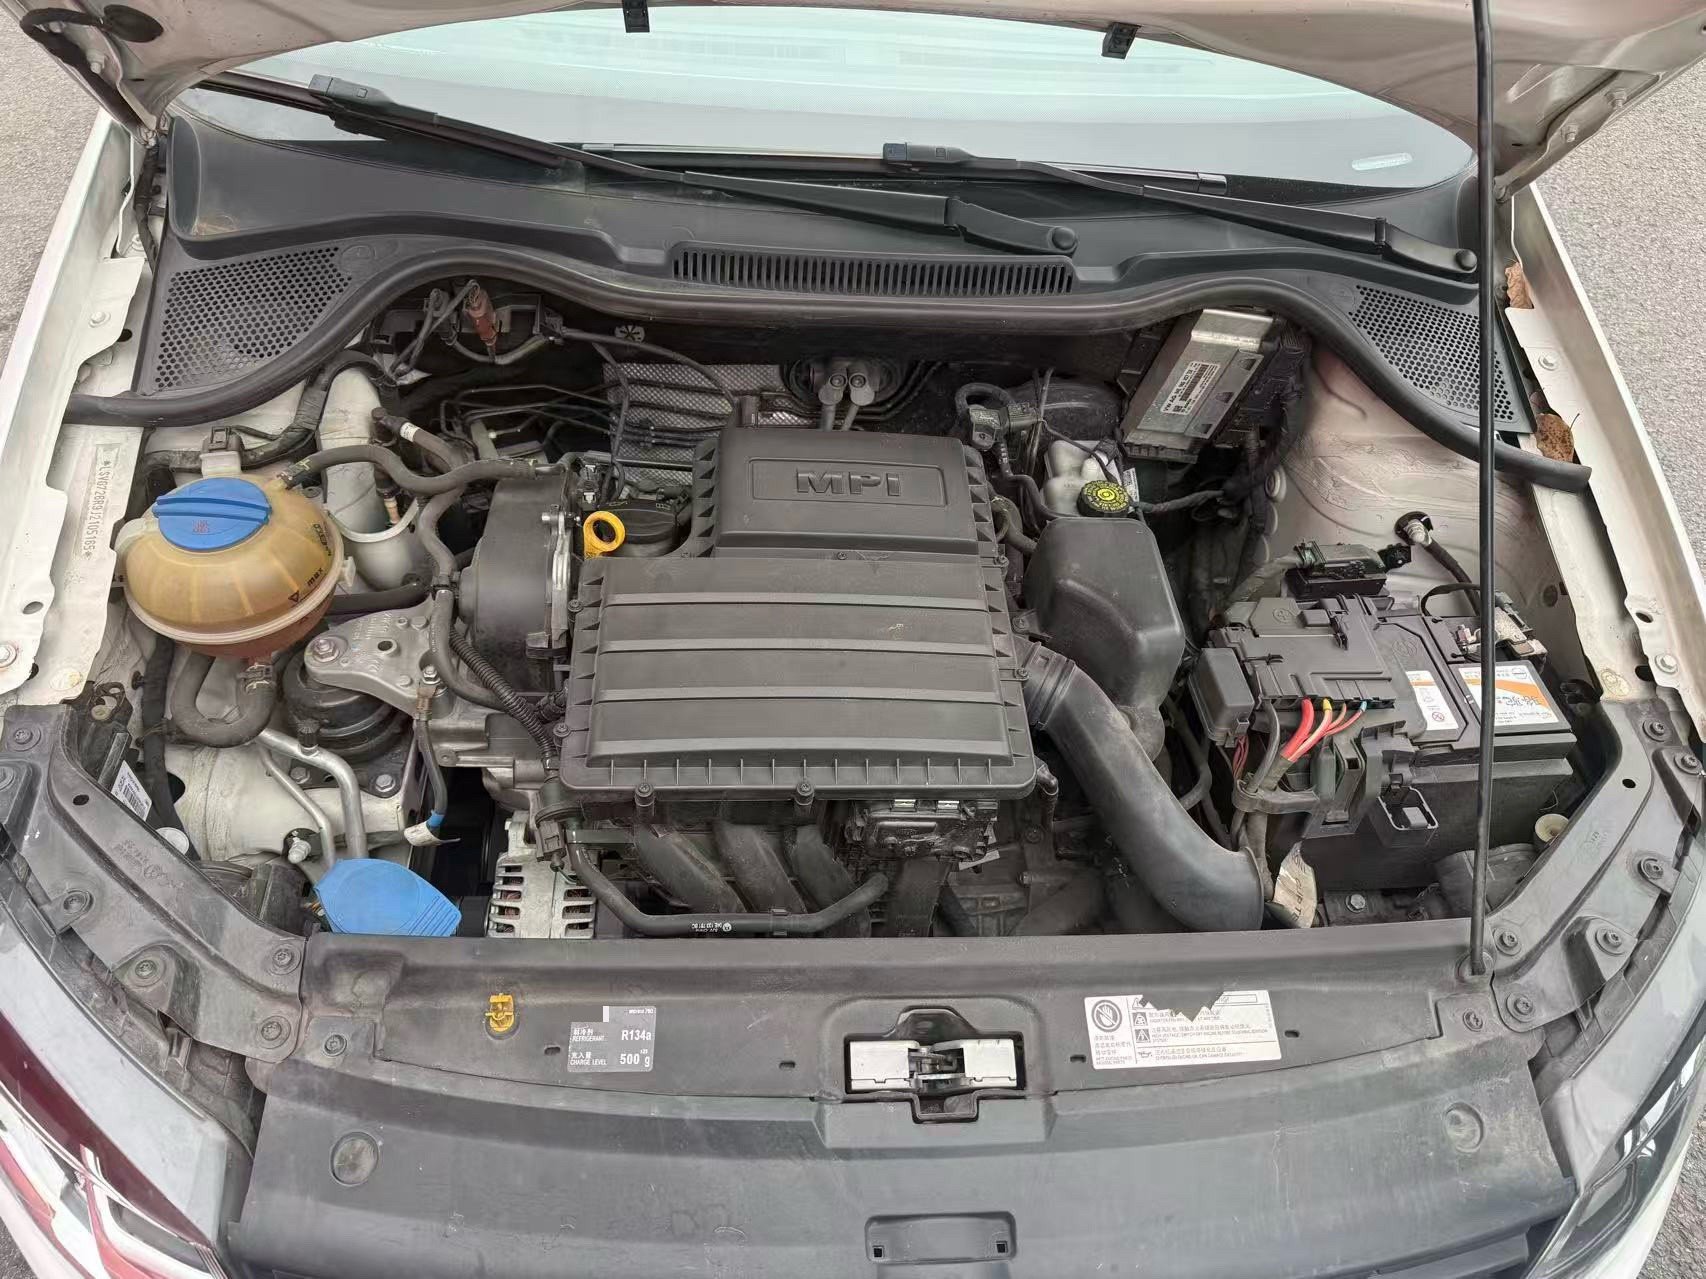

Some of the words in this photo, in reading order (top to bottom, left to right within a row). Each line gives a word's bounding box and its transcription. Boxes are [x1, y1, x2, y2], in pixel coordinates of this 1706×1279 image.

[796, 471, 901, 497] MPI
[307, 568, 326, 587] max
[621, 1029, 652, 1041] R134a
[619, 1053, 640, 1065] 500
[644, 1056, 650, 1068] g
